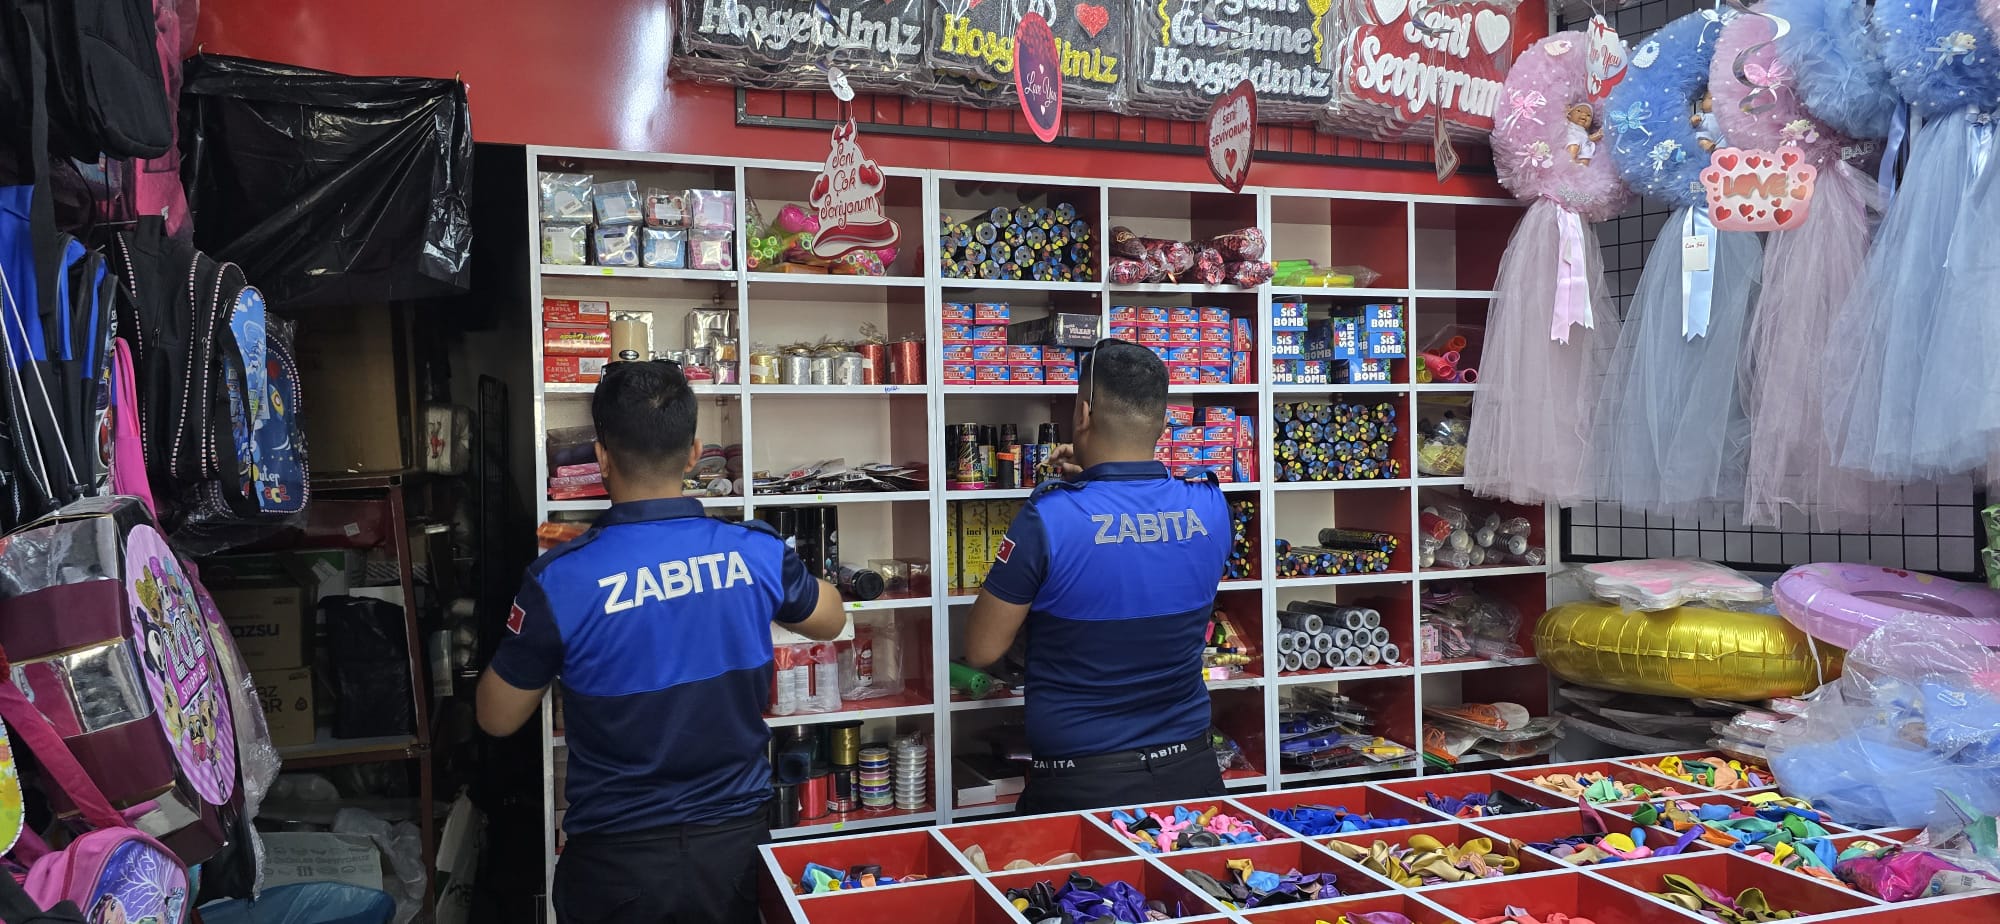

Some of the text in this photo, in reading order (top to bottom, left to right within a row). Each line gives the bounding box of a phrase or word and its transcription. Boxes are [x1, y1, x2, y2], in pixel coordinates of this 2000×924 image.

[832, 142, 855, 168] Seni
[833, 168, 856, 197] Çok
[1723, 172, 1790, 200] LOVE
[1273, 317, 1304, 327] BOMB
[1371, 319, 1399, 328] BOMB
[1346, 322, 1355, 355] BOMB
[1373, 344, 1402, 354] BOMB
[1271, 373, 1293, 383] OMB
[1297, 374, 1327, 384] BOMB
[1354, 372, 1386, 381] BOMB
[1091, 509, 1209, 545] ZABITA
[598, 551, 754, 614] ZABITA
